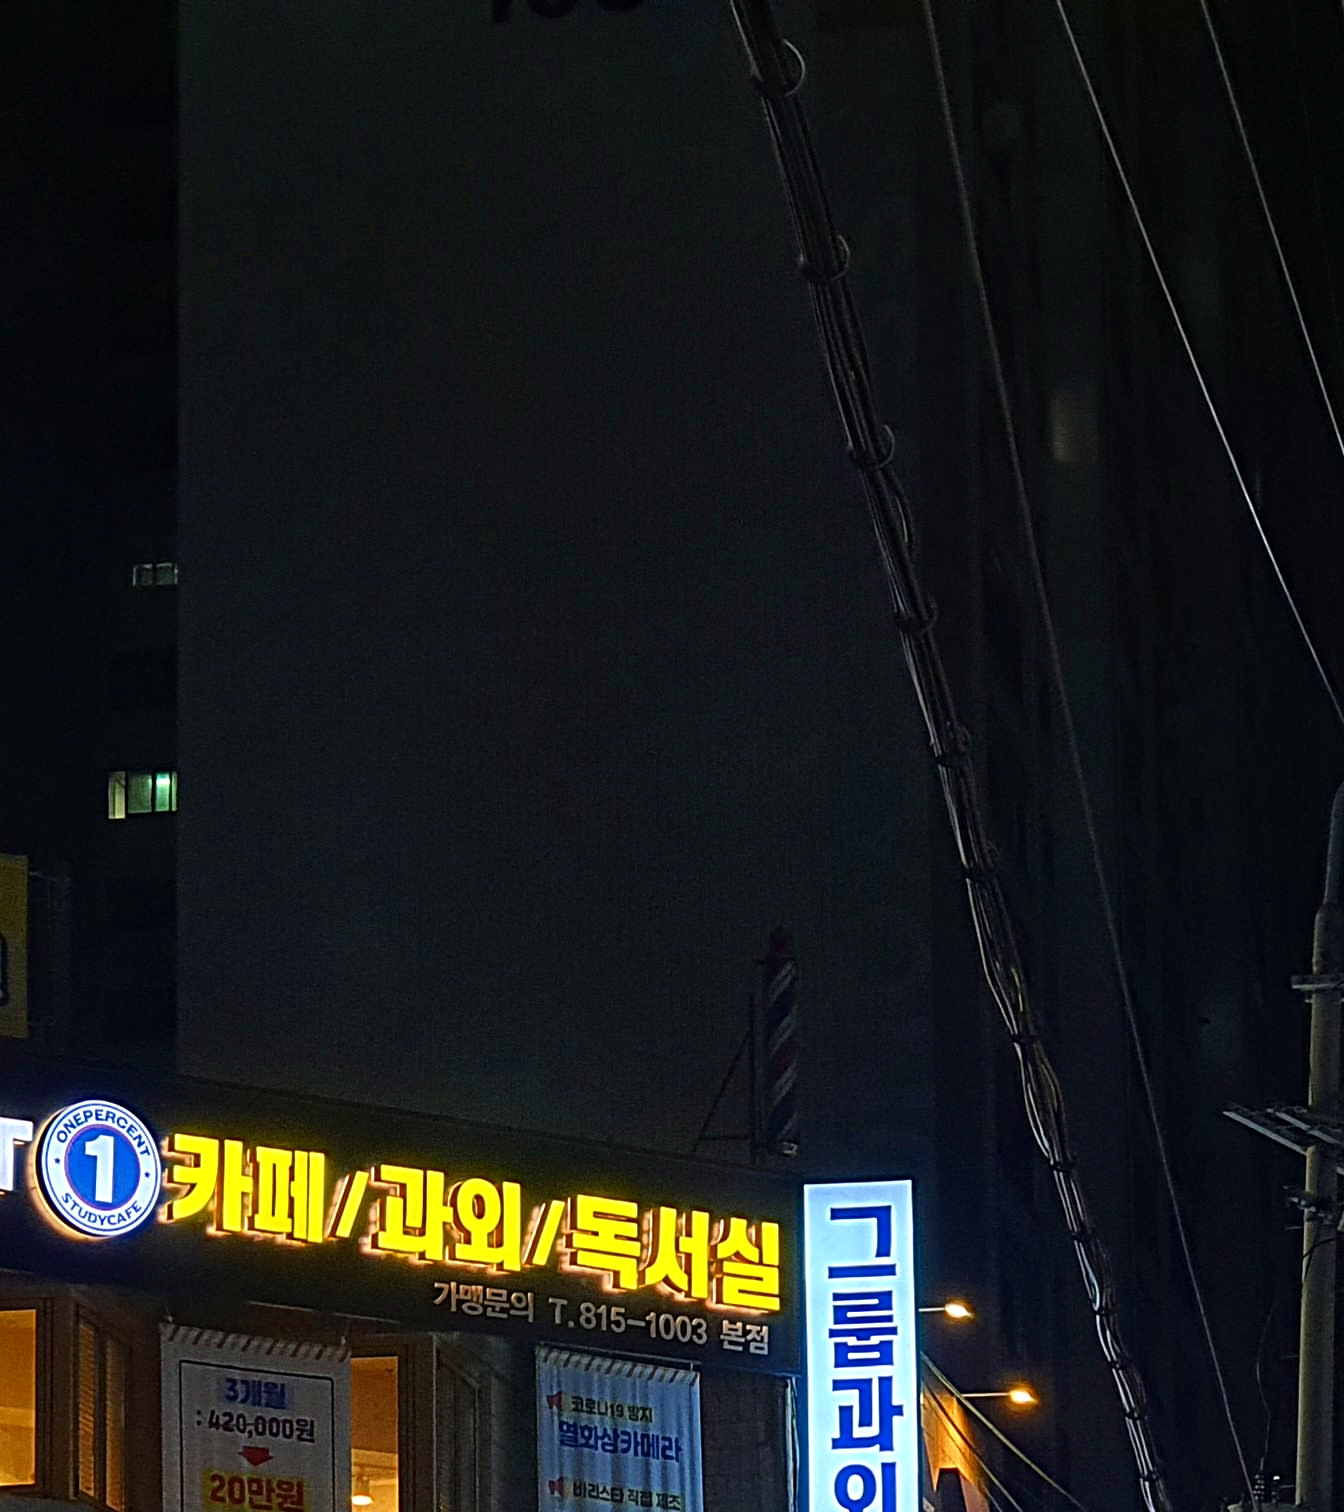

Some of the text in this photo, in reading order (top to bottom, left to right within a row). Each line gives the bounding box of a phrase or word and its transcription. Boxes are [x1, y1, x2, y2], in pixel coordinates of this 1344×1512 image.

[56, 1108, 151, 1158] ONEPERCENT
[85, 1134, 115, 1204] 1
[61, 1191, 143, 1227] STUDYCAFE
[433, 1282, 534, 1323] 가맹문의
[721, 1320, 769, 1355] 본점
[225, 1378, 286, 1409] 3개월
